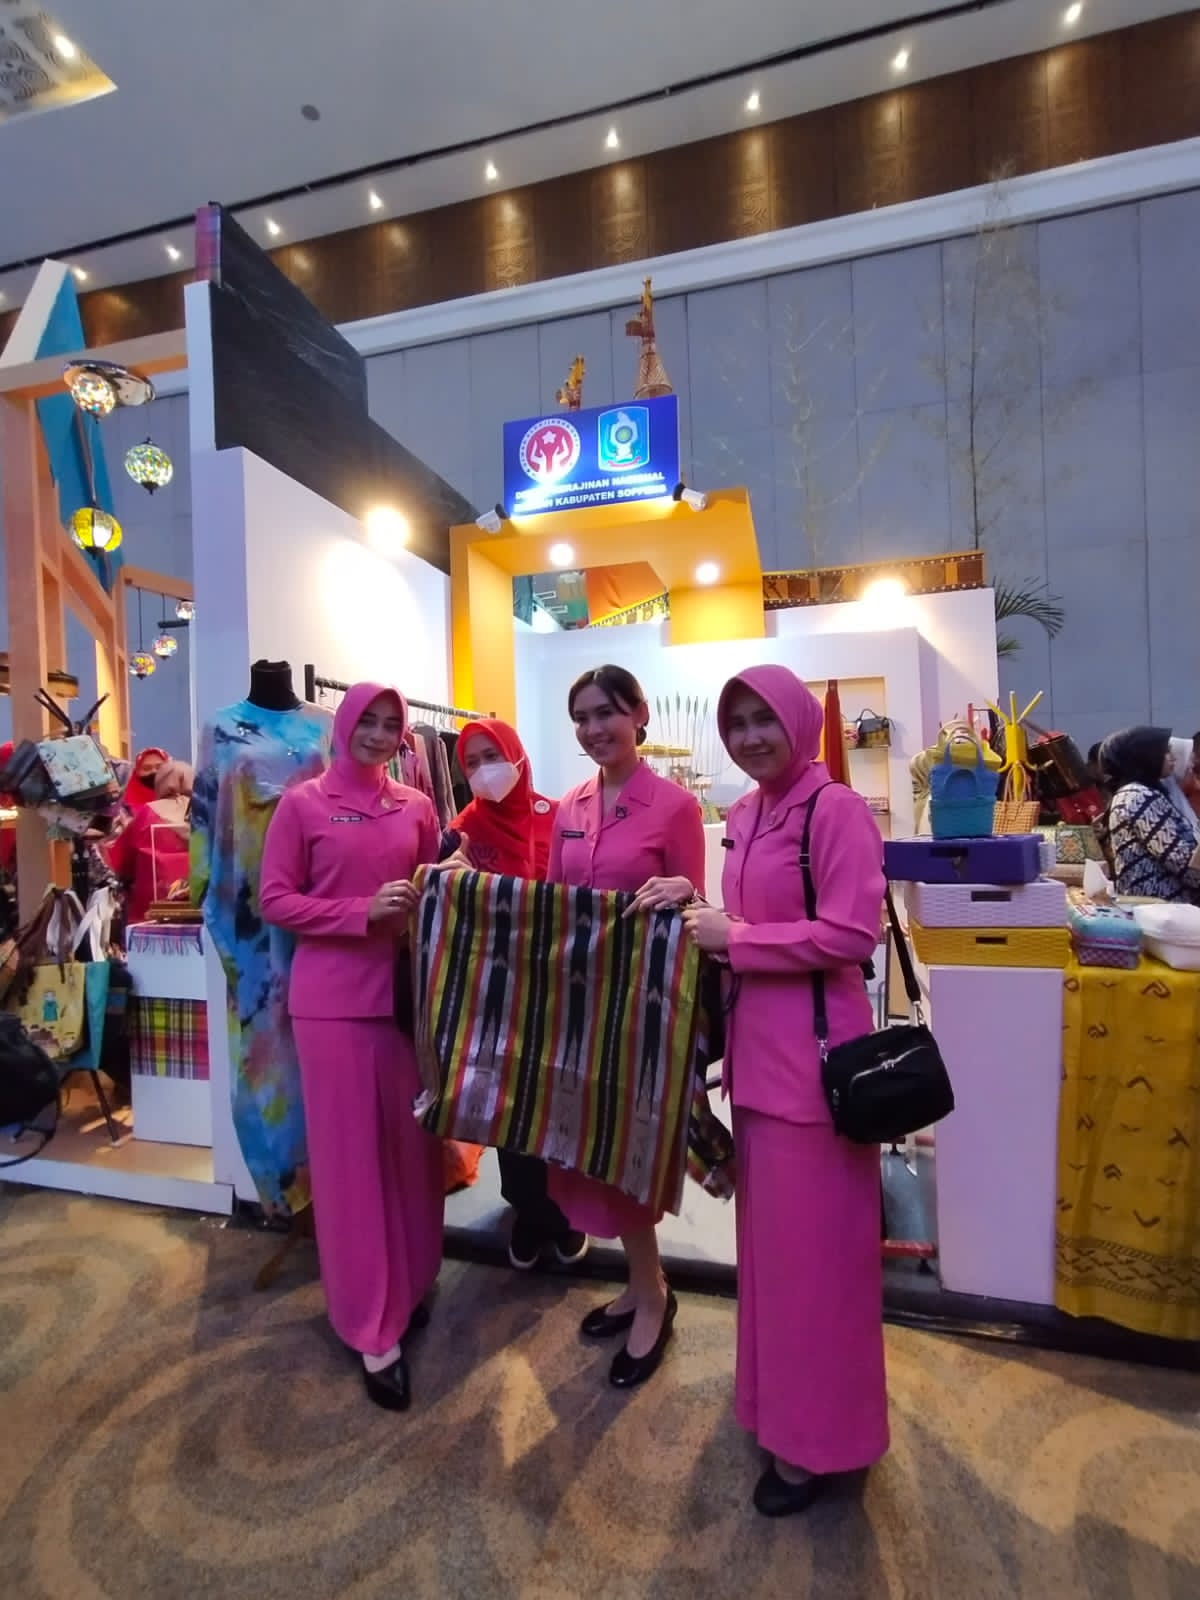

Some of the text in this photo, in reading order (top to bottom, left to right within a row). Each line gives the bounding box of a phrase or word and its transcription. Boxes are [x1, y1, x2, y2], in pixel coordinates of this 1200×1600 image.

[556, 479, 610, 495] RAJINAN
[612, 472, 665, 485] NANAL
[555, 491, 615, 506] KABUPATEN
[617, 484, 667, 498] SOPP
